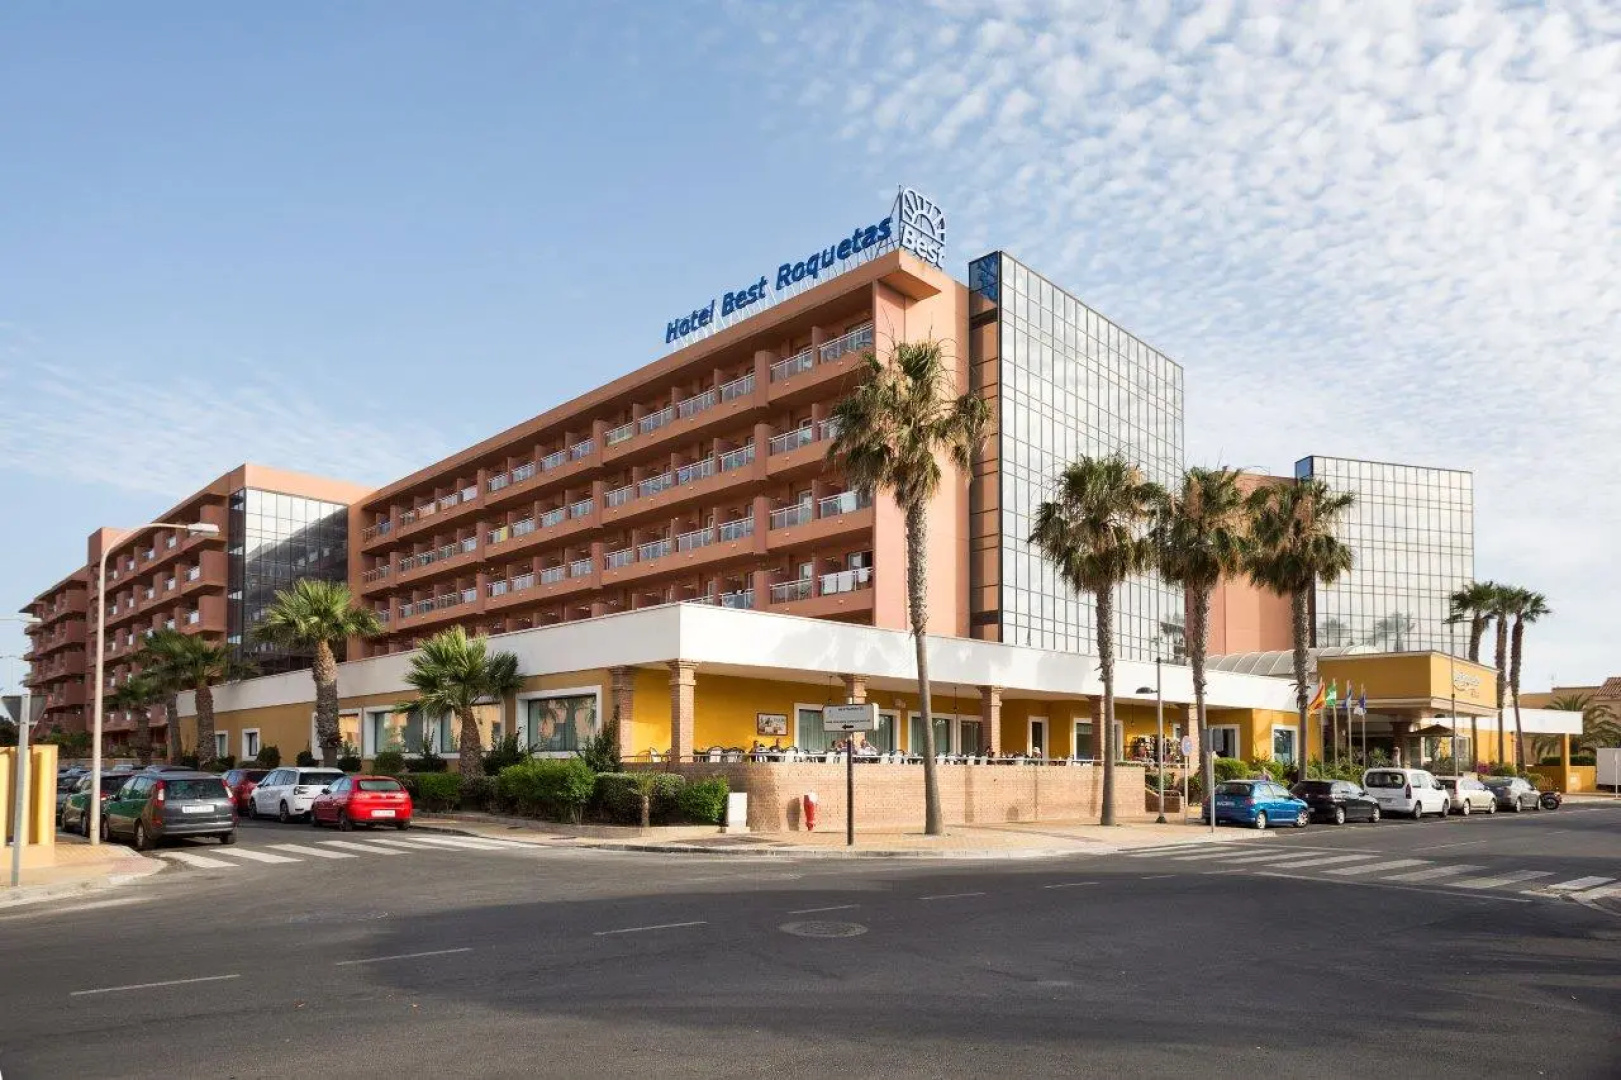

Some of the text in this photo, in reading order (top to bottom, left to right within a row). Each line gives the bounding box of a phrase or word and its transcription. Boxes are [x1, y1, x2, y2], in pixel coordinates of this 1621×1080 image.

[666, 216, 893, 343] Hotel Best Roquetas
[902, 223, 946, 269] Best
